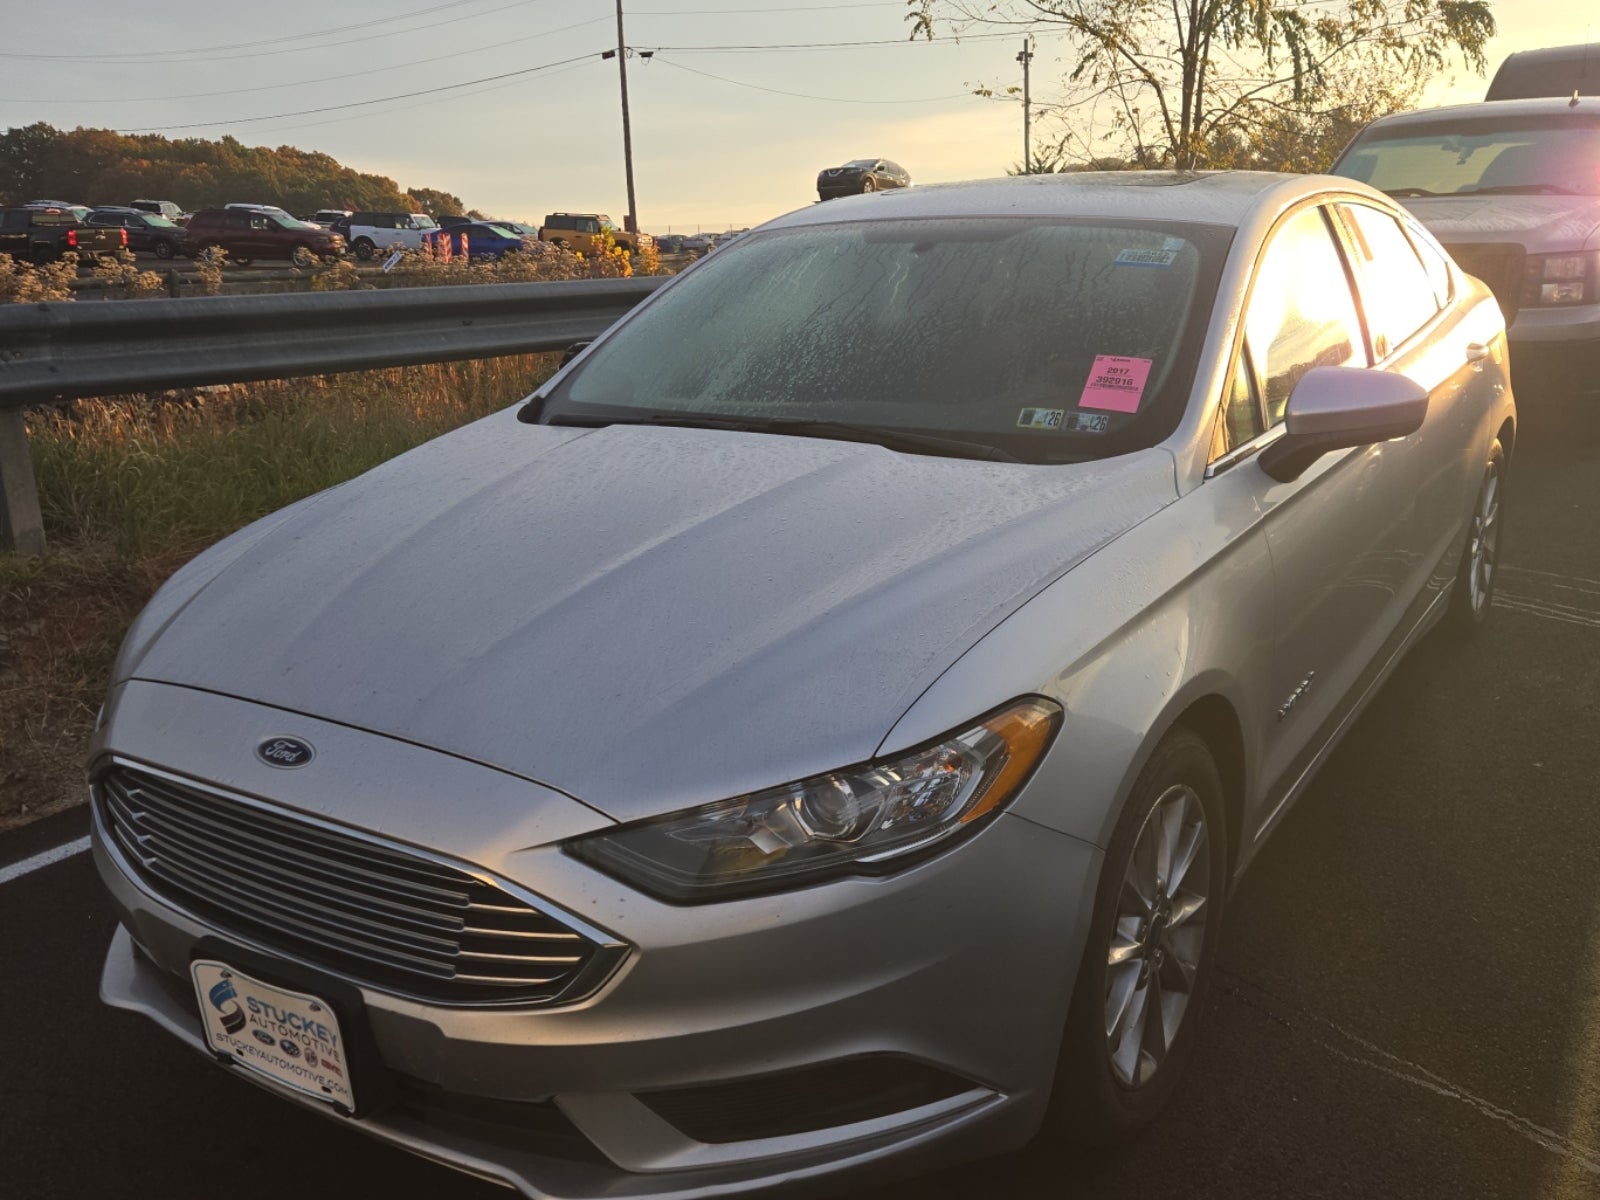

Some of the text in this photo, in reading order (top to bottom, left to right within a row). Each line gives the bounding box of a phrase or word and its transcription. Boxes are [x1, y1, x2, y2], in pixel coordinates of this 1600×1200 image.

[1096, 376, 1134, 386] 392916
[1107, 367, 1130, 375] 2017
[264, 740, 303, 762] Ford
[246, 996, 337, 1048] STUCKEY
[249, 1014, 341, 1063] AUTOMOTIVE
